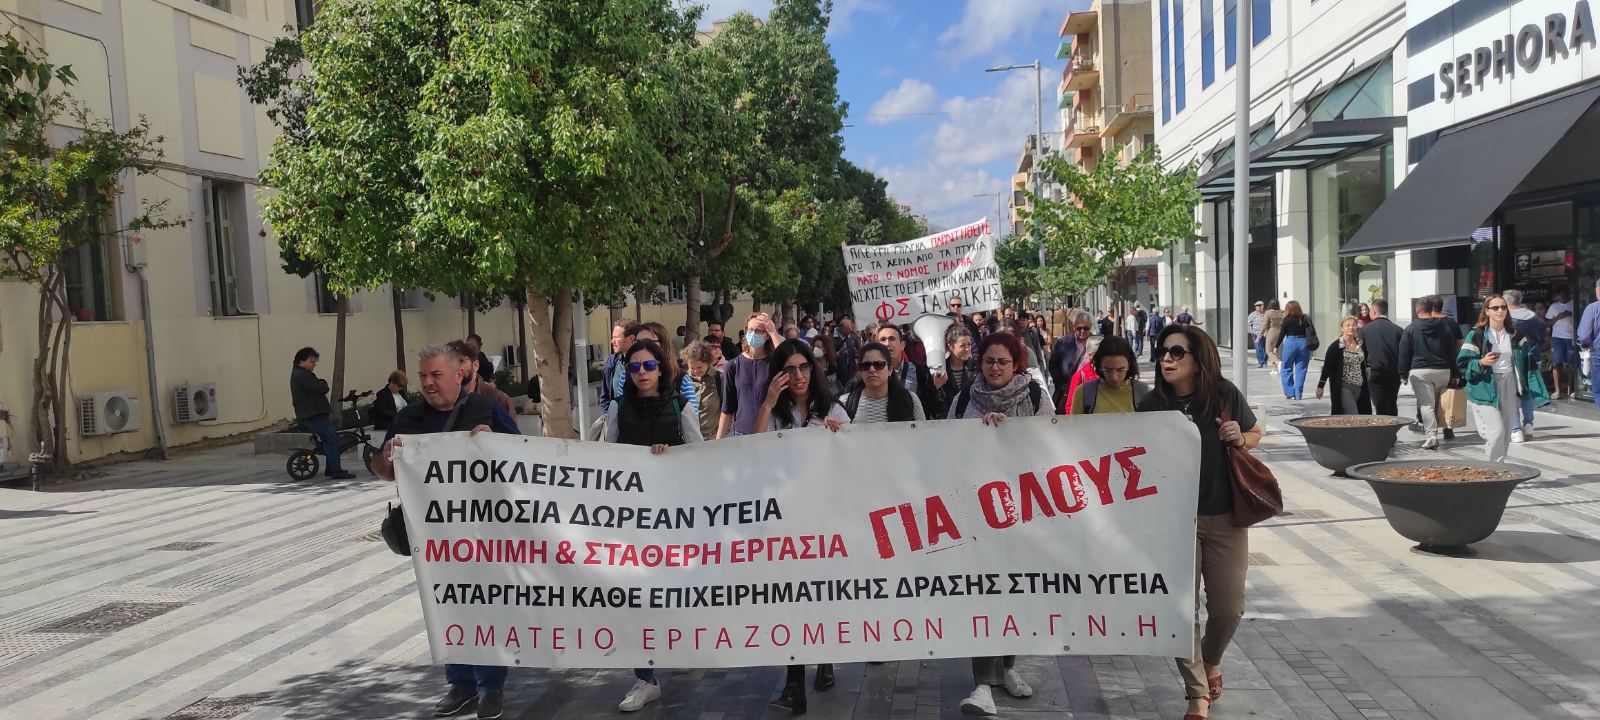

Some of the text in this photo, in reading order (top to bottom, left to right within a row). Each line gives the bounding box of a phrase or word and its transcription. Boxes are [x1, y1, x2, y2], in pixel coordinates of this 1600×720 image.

[1439, 0, 1597, 105] SEPHORA
[846, 241, 987, 274] ΑΤΩ ΤΑ ΧΕΡΙΑ ΑΠΟ ΤΑ ΠΤΥΧΙΑ
[886, 271, 892, 280] Ο
[897, 265, 930, 279] ΝΟΜΟΣ
[937, 256, 973, 272] ΓΚΑΓΚΑ
[850, 285, 892, 303] ΝΙΣΧΥΣΤΕ
[876, 298, 911, 321] ΦΣ
[423, 459, 645, 494] ΑΠΟΚΛΕΙΣΤΙΚΑ
[424, 497, 783, 530] ΔΗΜΟΣΙΑ ΔΩΡΕΑΝ ΥΓΕΙΑ
[868, 446, 1158, 561] ΓΙΑ ΟΛΟΥΣ
[425, 533, 849, 568] ΜΟΝΙΜΗ & ΣΤΑΘΕΡΗ ΕΡΓΑΣΙΑ
[572, 586, 642, 609] ΚΑΘΕ
[649, 577, 888, 609] ΕΠΙΧΕΙΡΗΜΑΤΙΚΗΣ
[895, 572, 1001, 598] ΔΡΑΣΗΣ
[1008, 572, 1081, 595] ΣΤΗΝ
[1088, 573, 1169, 596] ΥΓΕΙΑ
[445, 623, 615, 651] ΩΜΑΤΕΙΟ
[643, 617, 943, 651] ΕΡΓΑΖΟΜΕΝΩΝ
